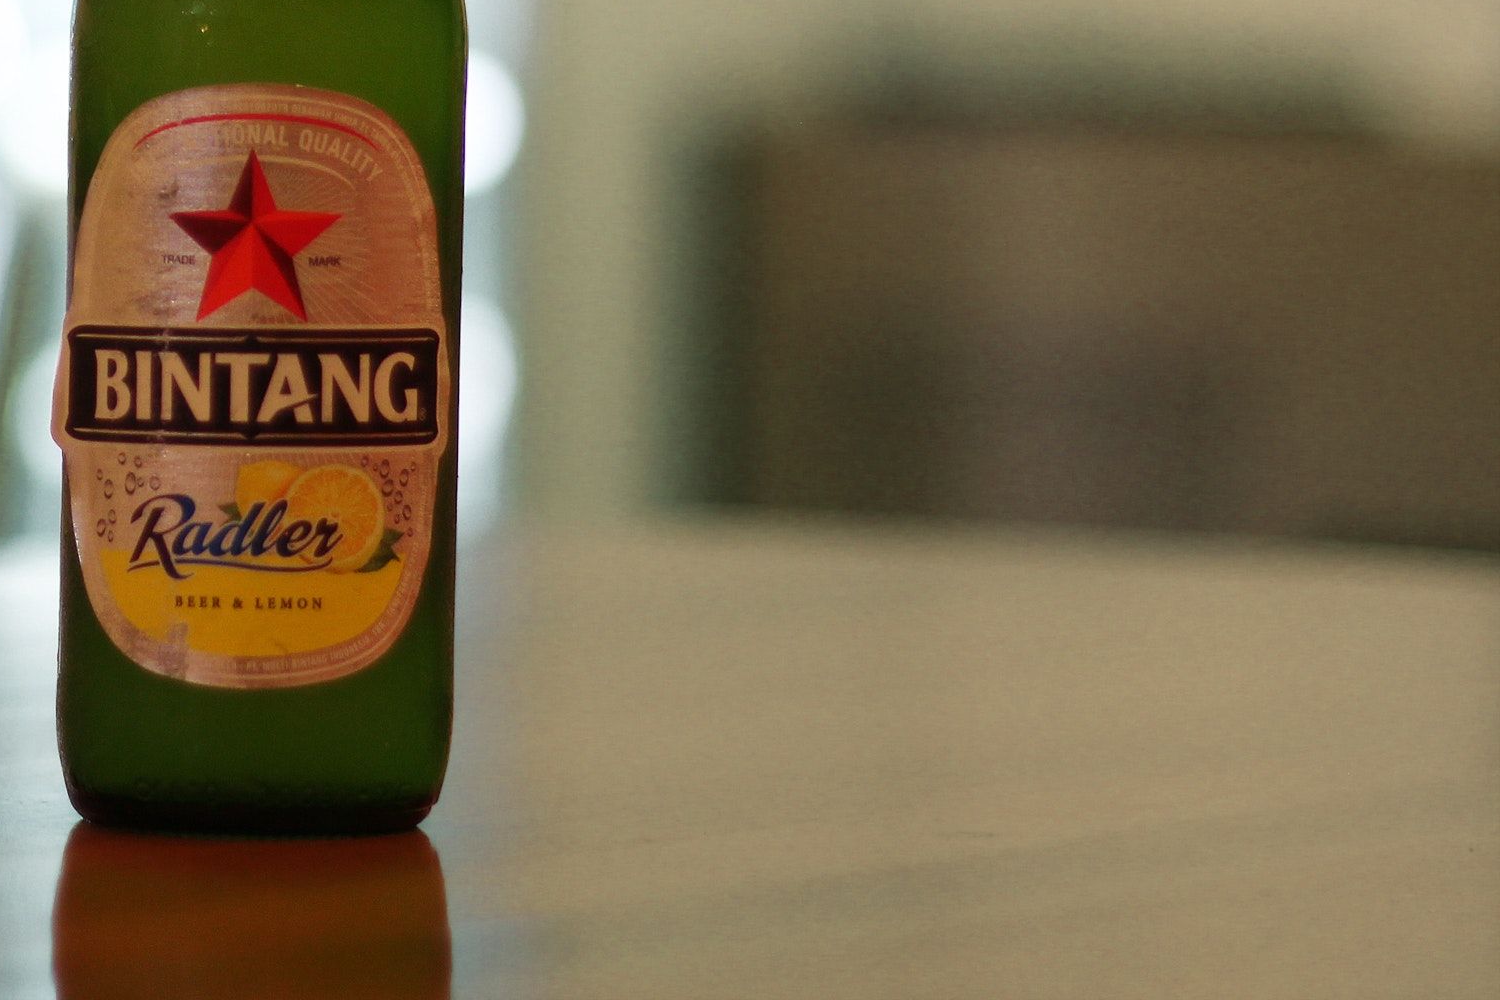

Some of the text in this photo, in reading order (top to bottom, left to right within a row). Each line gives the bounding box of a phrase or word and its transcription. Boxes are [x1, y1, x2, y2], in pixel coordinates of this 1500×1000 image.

[299, 128, 384, 183] QUALITY
[161, 254, 342, 267] TRADE MARK
[93, 347, 419, 424] BINTANG
[126, 493, 344, 582] Radler
[174, 595, 323, 610] BEER & LEMON
